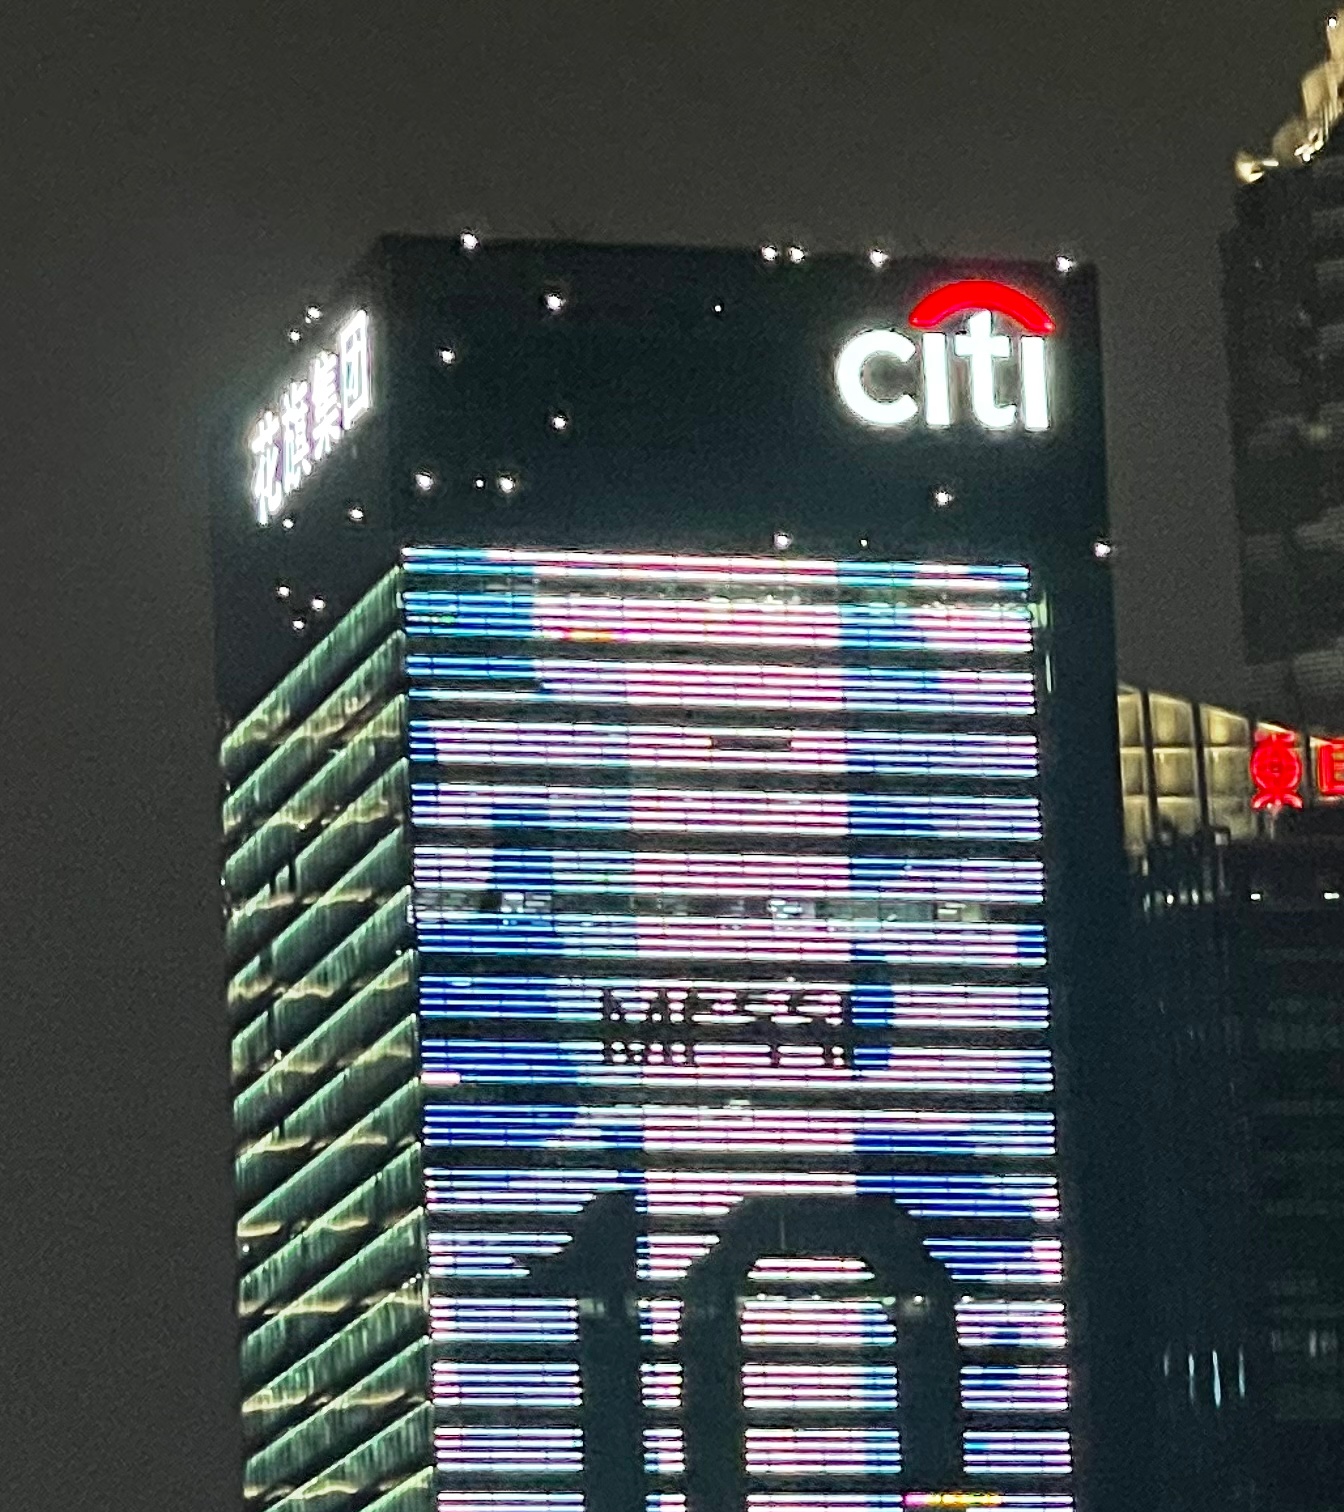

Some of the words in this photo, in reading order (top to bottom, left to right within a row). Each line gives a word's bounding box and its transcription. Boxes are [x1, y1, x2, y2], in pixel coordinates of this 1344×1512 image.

[252, 309, 371, 526] 花旗集团
[837, 308, 1051, 432] citi
[602, 984, 853, 1068] MESSI
